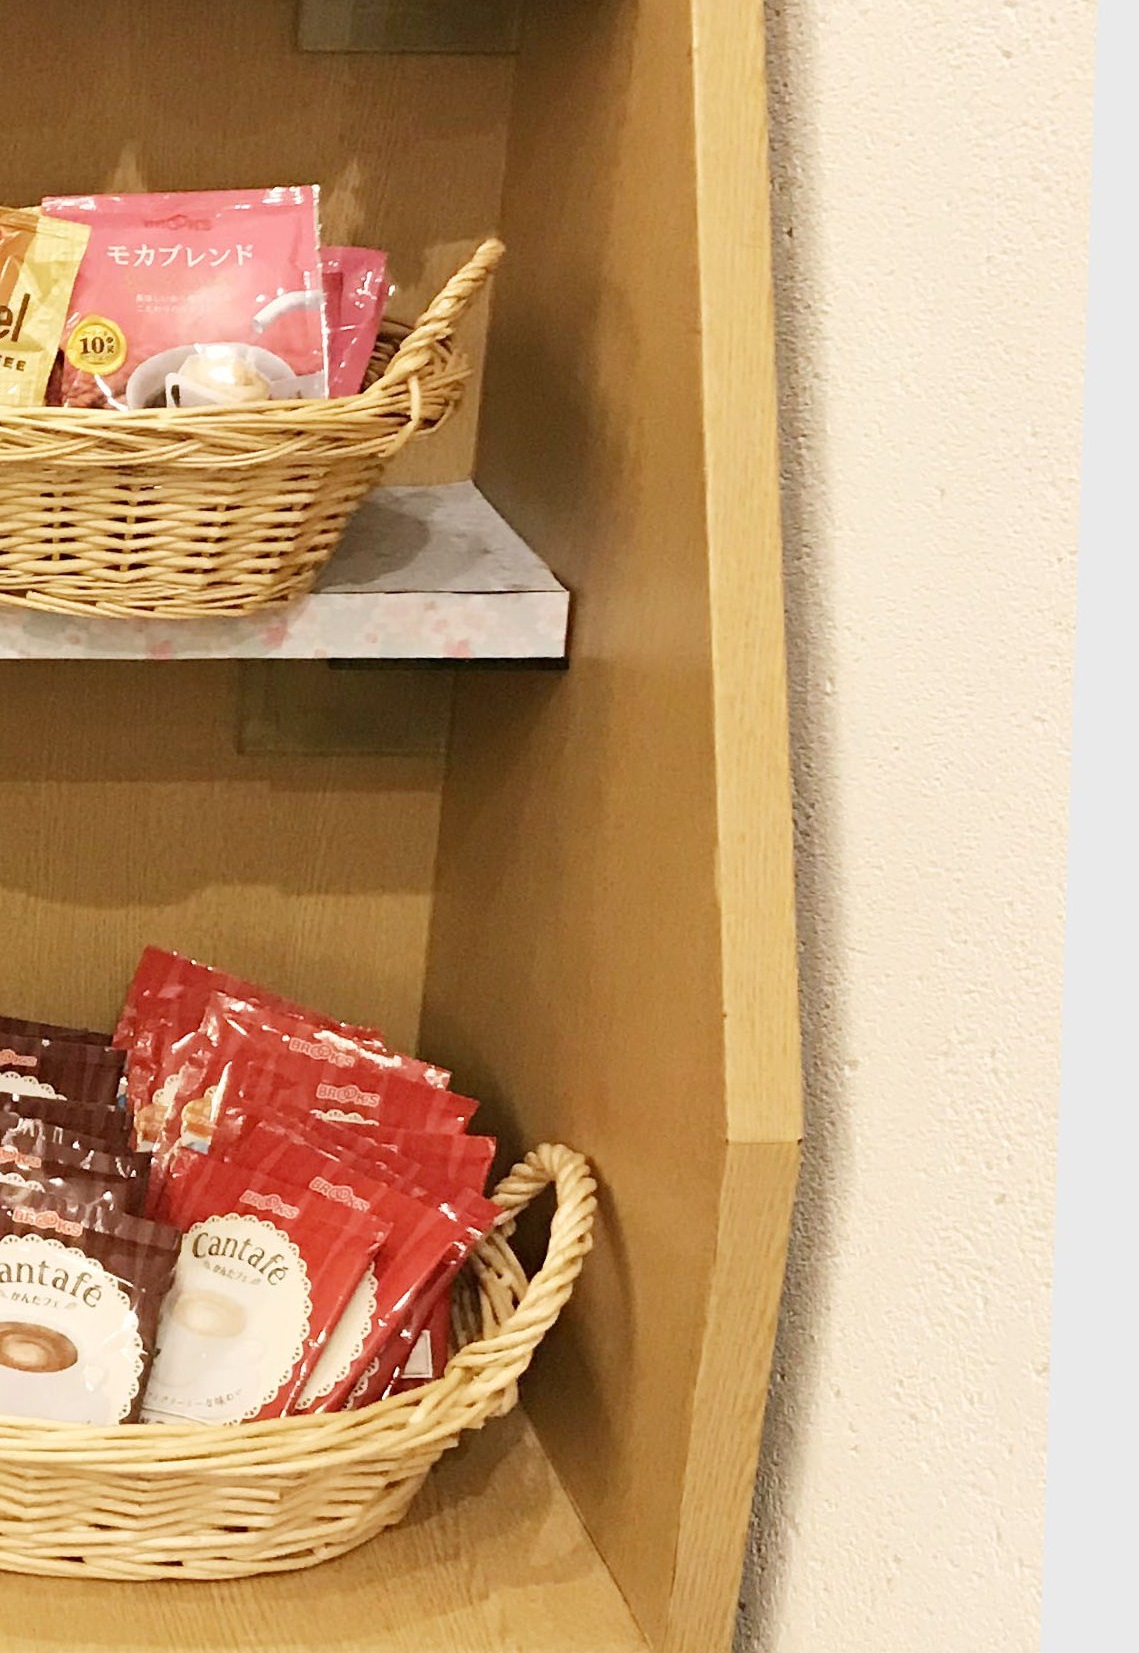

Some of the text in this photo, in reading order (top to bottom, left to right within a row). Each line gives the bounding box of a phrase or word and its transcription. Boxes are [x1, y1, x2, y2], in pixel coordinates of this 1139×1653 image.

[107, 244, 254, 268] モカブレンド
[191, 1231, 290, 1287] Cantafé
